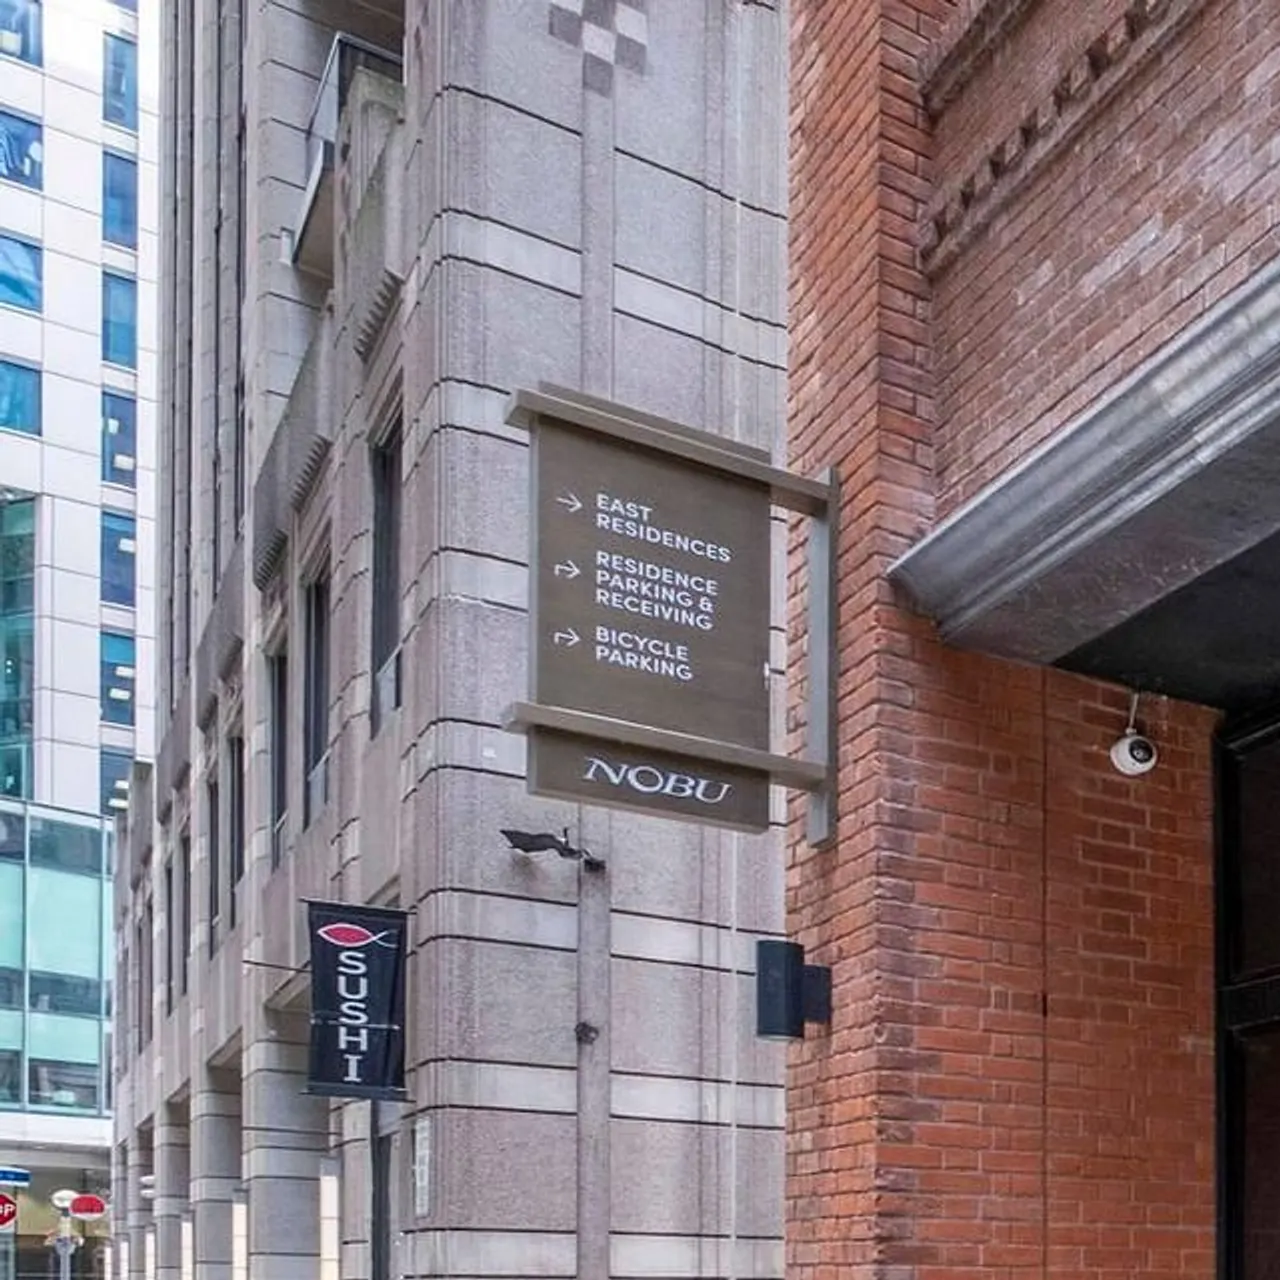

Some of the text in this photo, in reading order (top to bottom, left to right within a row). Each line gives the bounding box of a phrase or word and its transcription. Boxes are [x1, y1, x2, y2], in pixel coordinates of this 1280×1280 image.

[595, 493, 653, 521] EAST
[595, 513, 732, 563] RESIDENCES
[595, 550, 718, 596] RESIDENCE
[595, 570, 714, 613] PARKING &
[595, 588, 714, 631] RECEIVING
[595, 626, 690, 662] BICYCLE
[595, 646, 694, 681] PARKING
[583, 756, 732, 804] NOBU
[337, 951, 369, 1083] SUSHI
